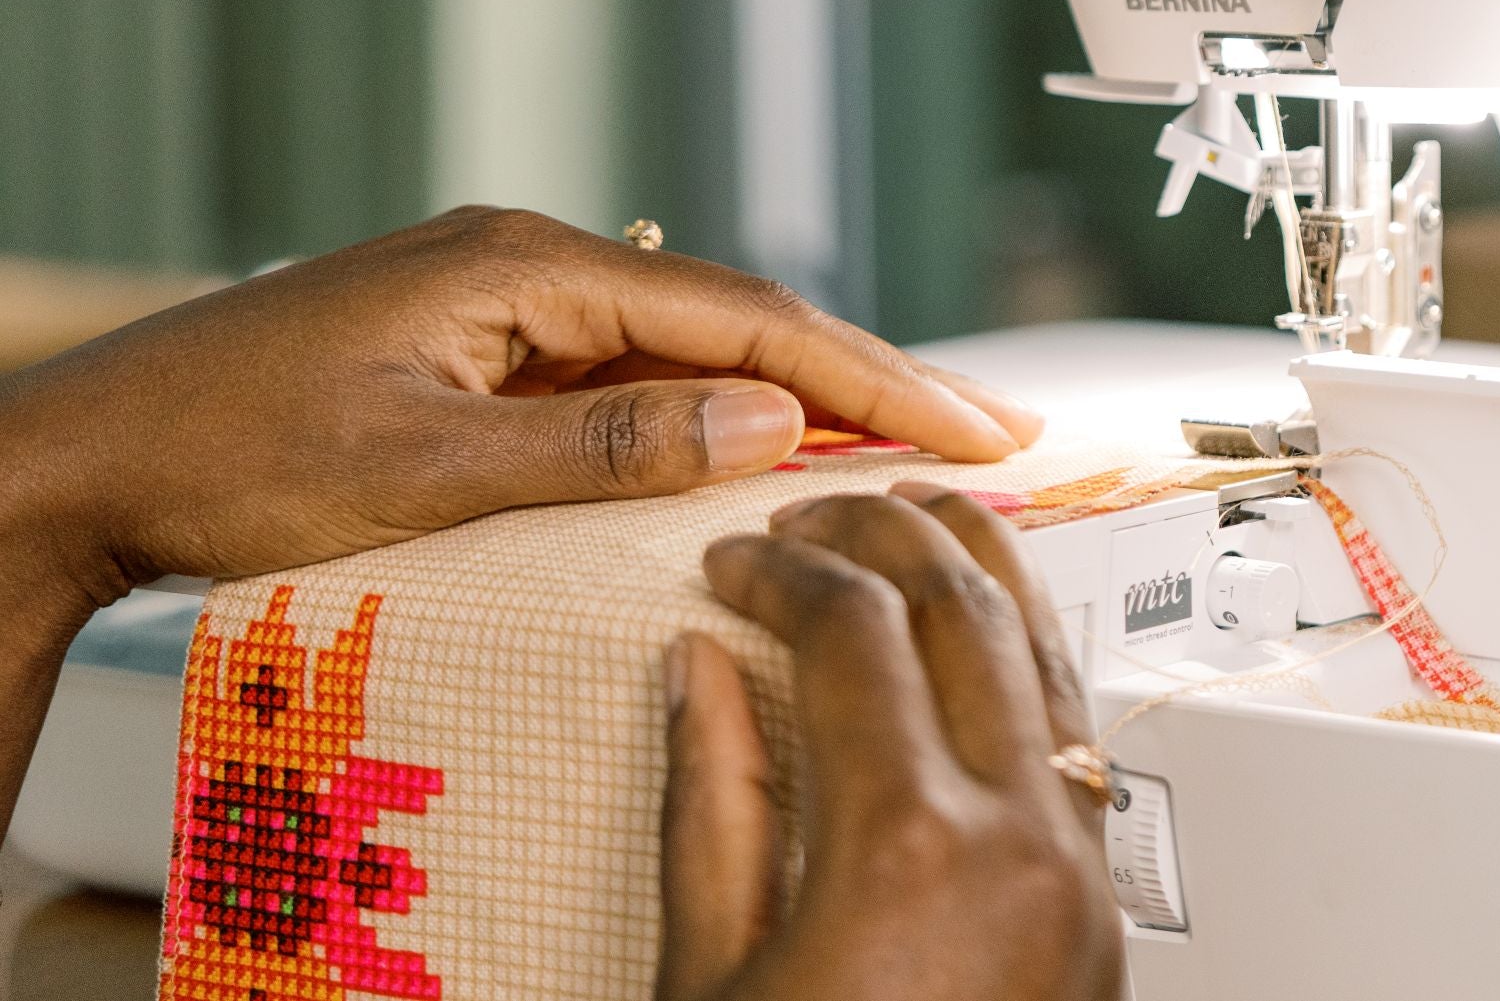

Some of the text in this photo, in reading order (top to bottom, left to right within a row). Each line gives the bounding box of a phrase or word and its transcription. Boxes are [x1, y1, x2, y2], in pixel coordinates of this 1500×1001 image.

[1125, 569, 1187, 616] mtc
[1125, 621, 1194, 647] micro thread control
[1115, 790, 1128, 811] 6
[1113, 867, 1135, 885] 6.5
